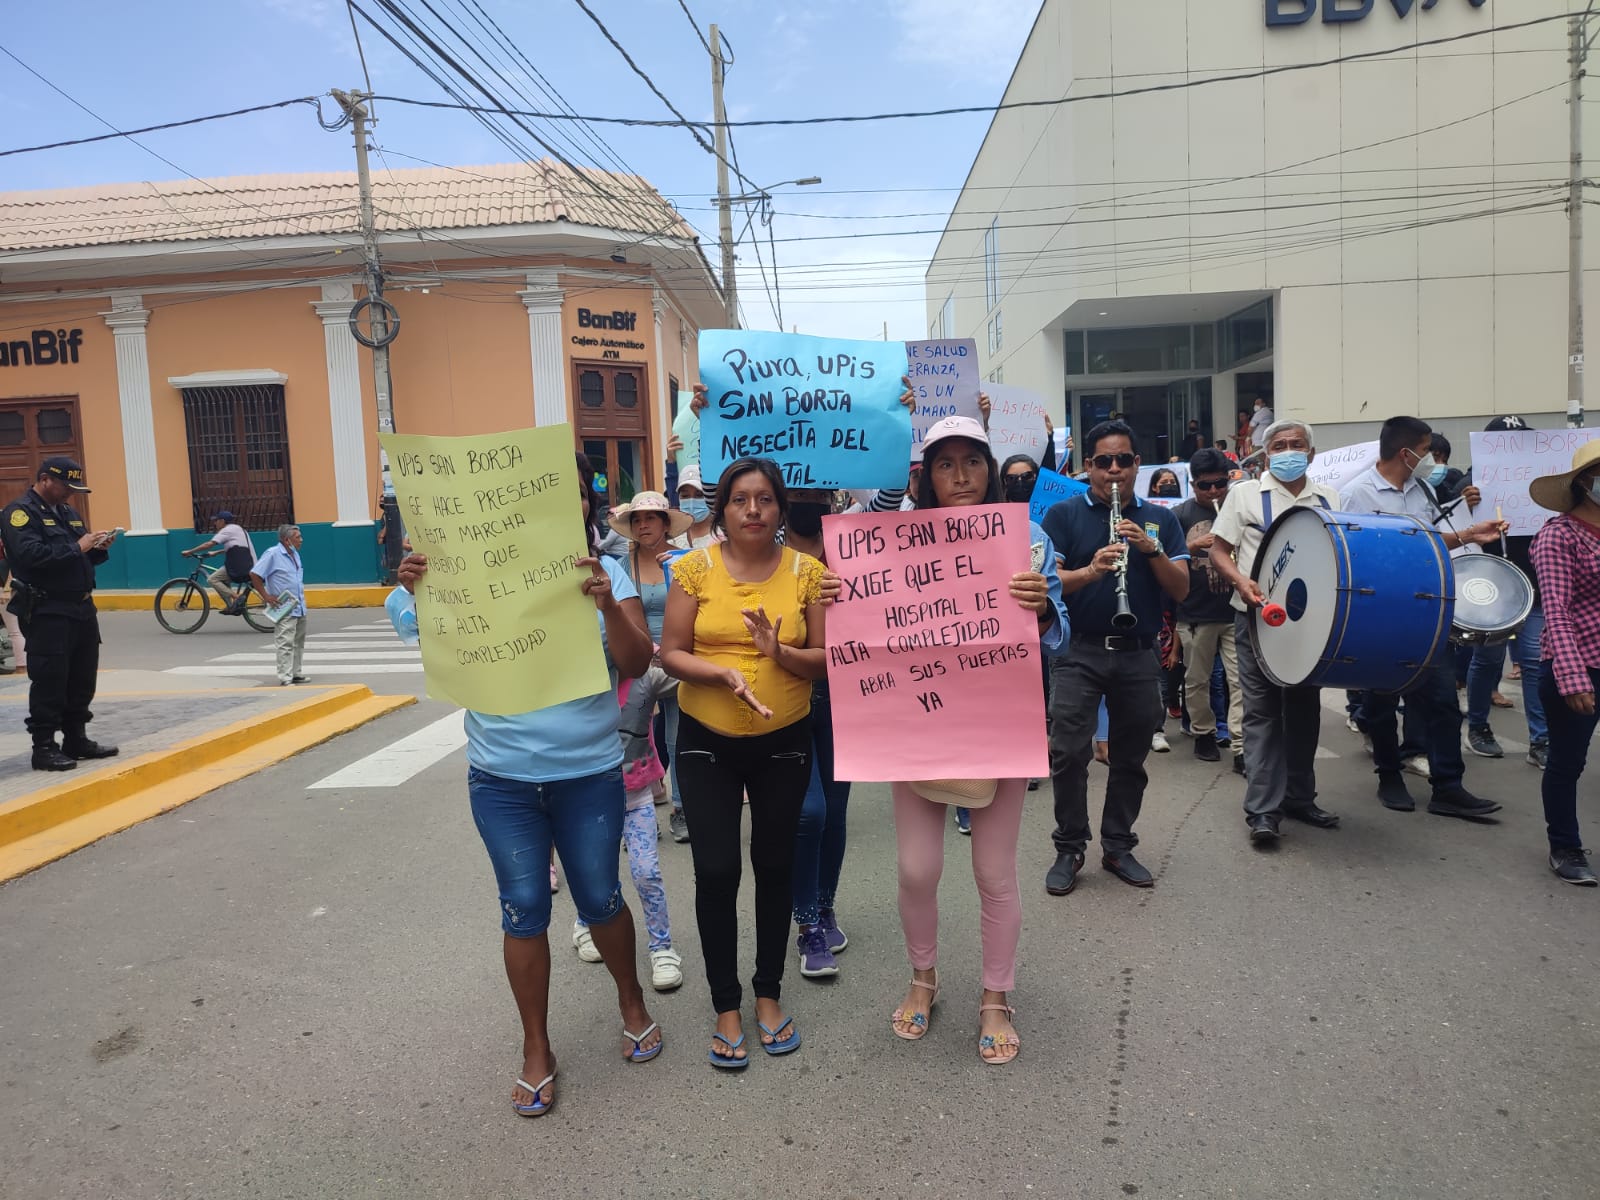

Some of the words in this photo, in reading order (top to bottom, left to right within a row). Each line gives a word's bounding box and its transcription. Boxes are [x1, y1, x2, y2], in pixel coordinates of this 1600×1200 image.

[577, 308, 637, 331] BanBif
[0, 329, 83, 367] nBif
[602, 350, 620, 359] ATM
[925, 345, 968, 358] SALUD
[908, 362, 959, 380] ERANZA,
[936, 384, 955, 398] UN
[719, 390, 774, 420] SAN
[782, 386, 851, 416] BORJA
[914, 404, 957, 417] UMANO
[991, 396, 1017, 416] LAS
[829, 428, 870, 451] DEL
[1482, 431, 1524, 455] SAN
[397, 452, 424, 478] UPIS
[429, 454, 456, 476] SAN
[466, 445, 523, 474] BORJA
[1482, 464, 1533, 486] EXIGE
[408, 496, 424, 516] SE
[432, 496, 465, 518] HACE
[473, 472, 561, 513] PRESENTE
[1043, 480, 1066, 495] UPIS
[458, 512, 527, 544] MARCHA
[838, 526, 886, 560] UPIS
[896, 521, 937, 552] SAN
[945, 511, 1006, 543] BORJA
[483, 544, 520, 568] QUE
[905, 559, 945, 592] QUE
[955, 554, 984, 578] EL
[488, 581, 516, 600] EL
[885, 597, 964, 630] HOSPITAL
[975, 588, 999, 612] DE
[433, 617, 448, 636] DE
[456, 615, 491, 637] ALTA
[456, 628, 547, 666] COMPLEJIDAD
[830, 639, 871, 667] ALTA
[886, 617, 1000, 655] COMPLEJIDAD
[859, 671, 897, 697] ABRA
[909, 660, 947, 682] SUS
[957, 642, 1029, 672] PUERTAS
[917, 691, 944, 713] YA
